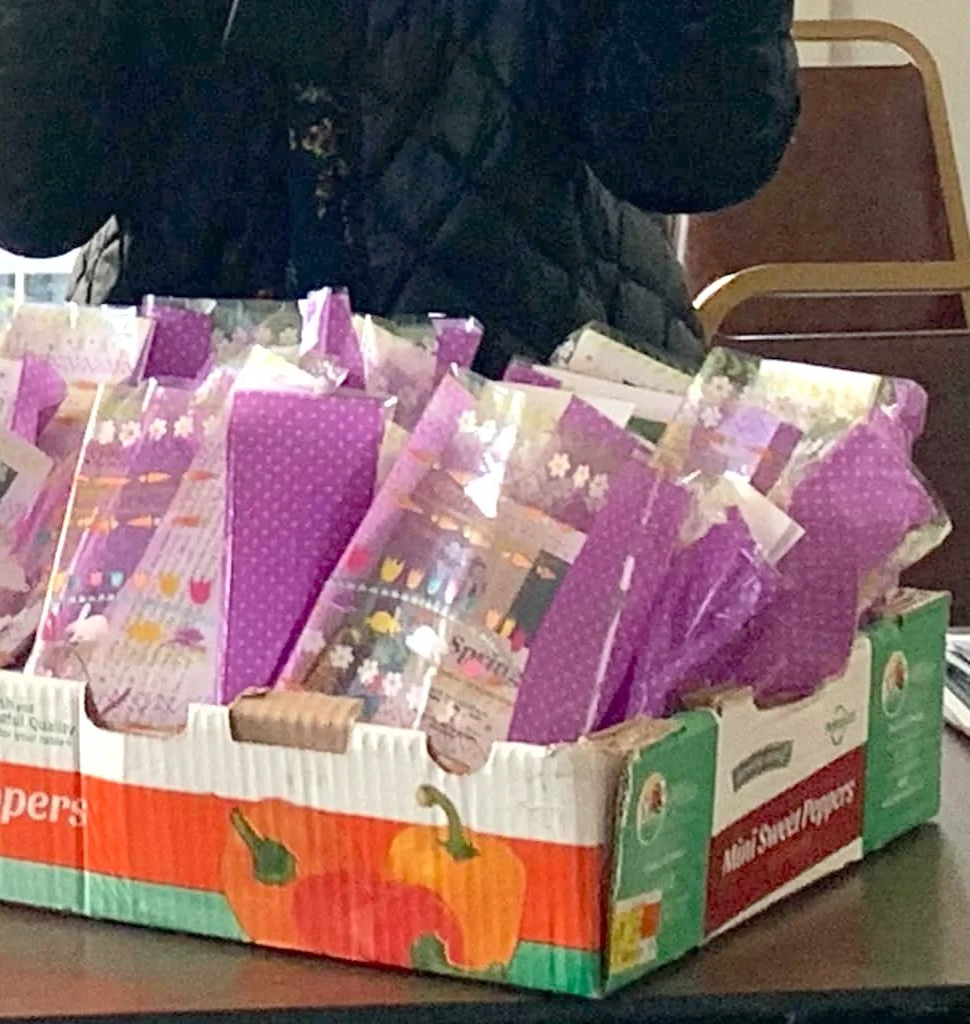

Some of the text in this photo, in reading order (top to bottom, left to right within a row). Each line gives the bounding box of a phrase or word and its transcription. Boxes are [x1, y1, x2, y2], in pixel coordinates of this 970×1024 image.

[721, 827, 758, 875] Mini
[757, 806, 802, 854] Sweet
[801, 779, 855, 829] Peppers
